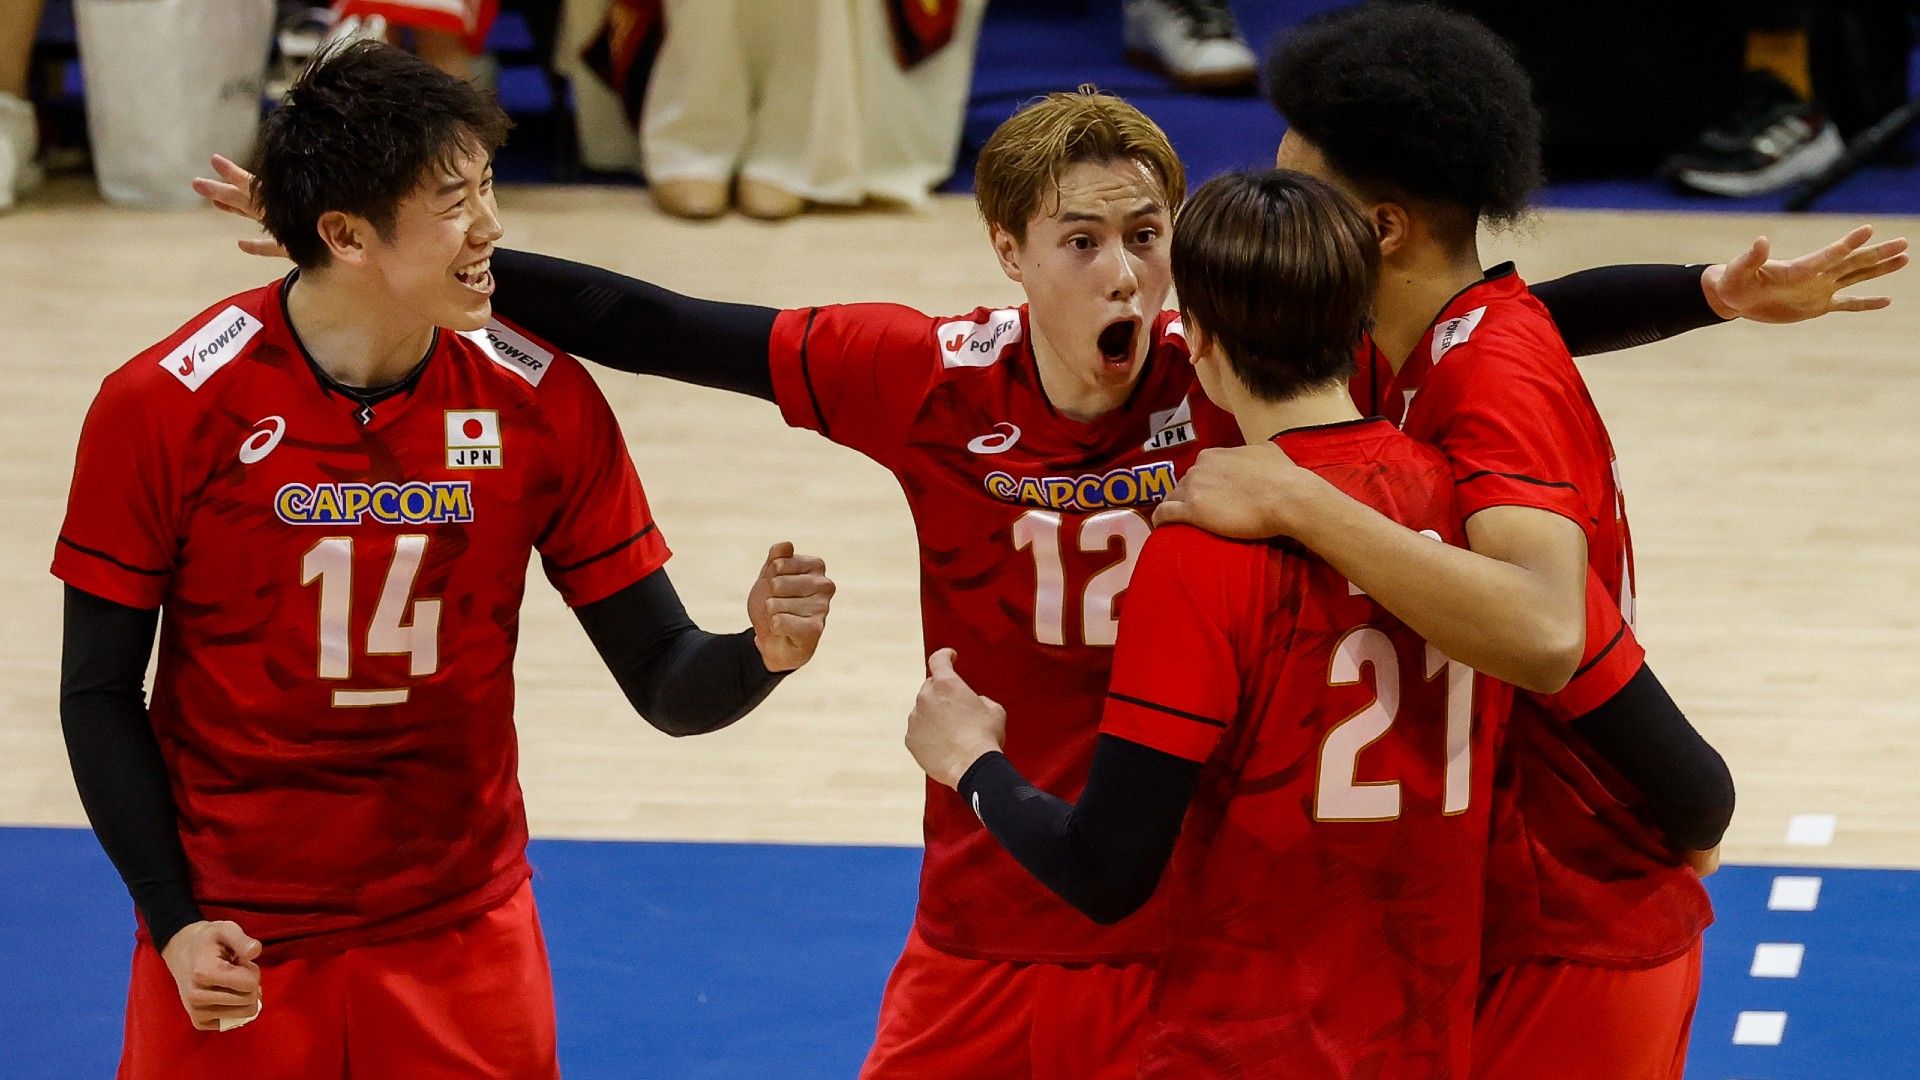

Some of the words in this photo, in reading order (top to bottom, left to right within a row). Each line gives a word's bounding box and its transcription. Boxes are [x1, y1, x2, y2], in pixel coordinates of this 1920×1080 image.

[198, 316, 247, 362] POWER
[486, 333, 543, 371] POWER
[970, 320, 1014, 353] POWER
[456, 450, 492, 465] JPN
[1151, 426, 1187, 447] JPN
[275, 481, 474, 525] CAPCOM
[985, 461, 1176, 511] CAPCOM
[1011, 508, 1152, 646] 12
[300, 534, 443, 680] 14
[1313, 624, 1474, 823] 21
